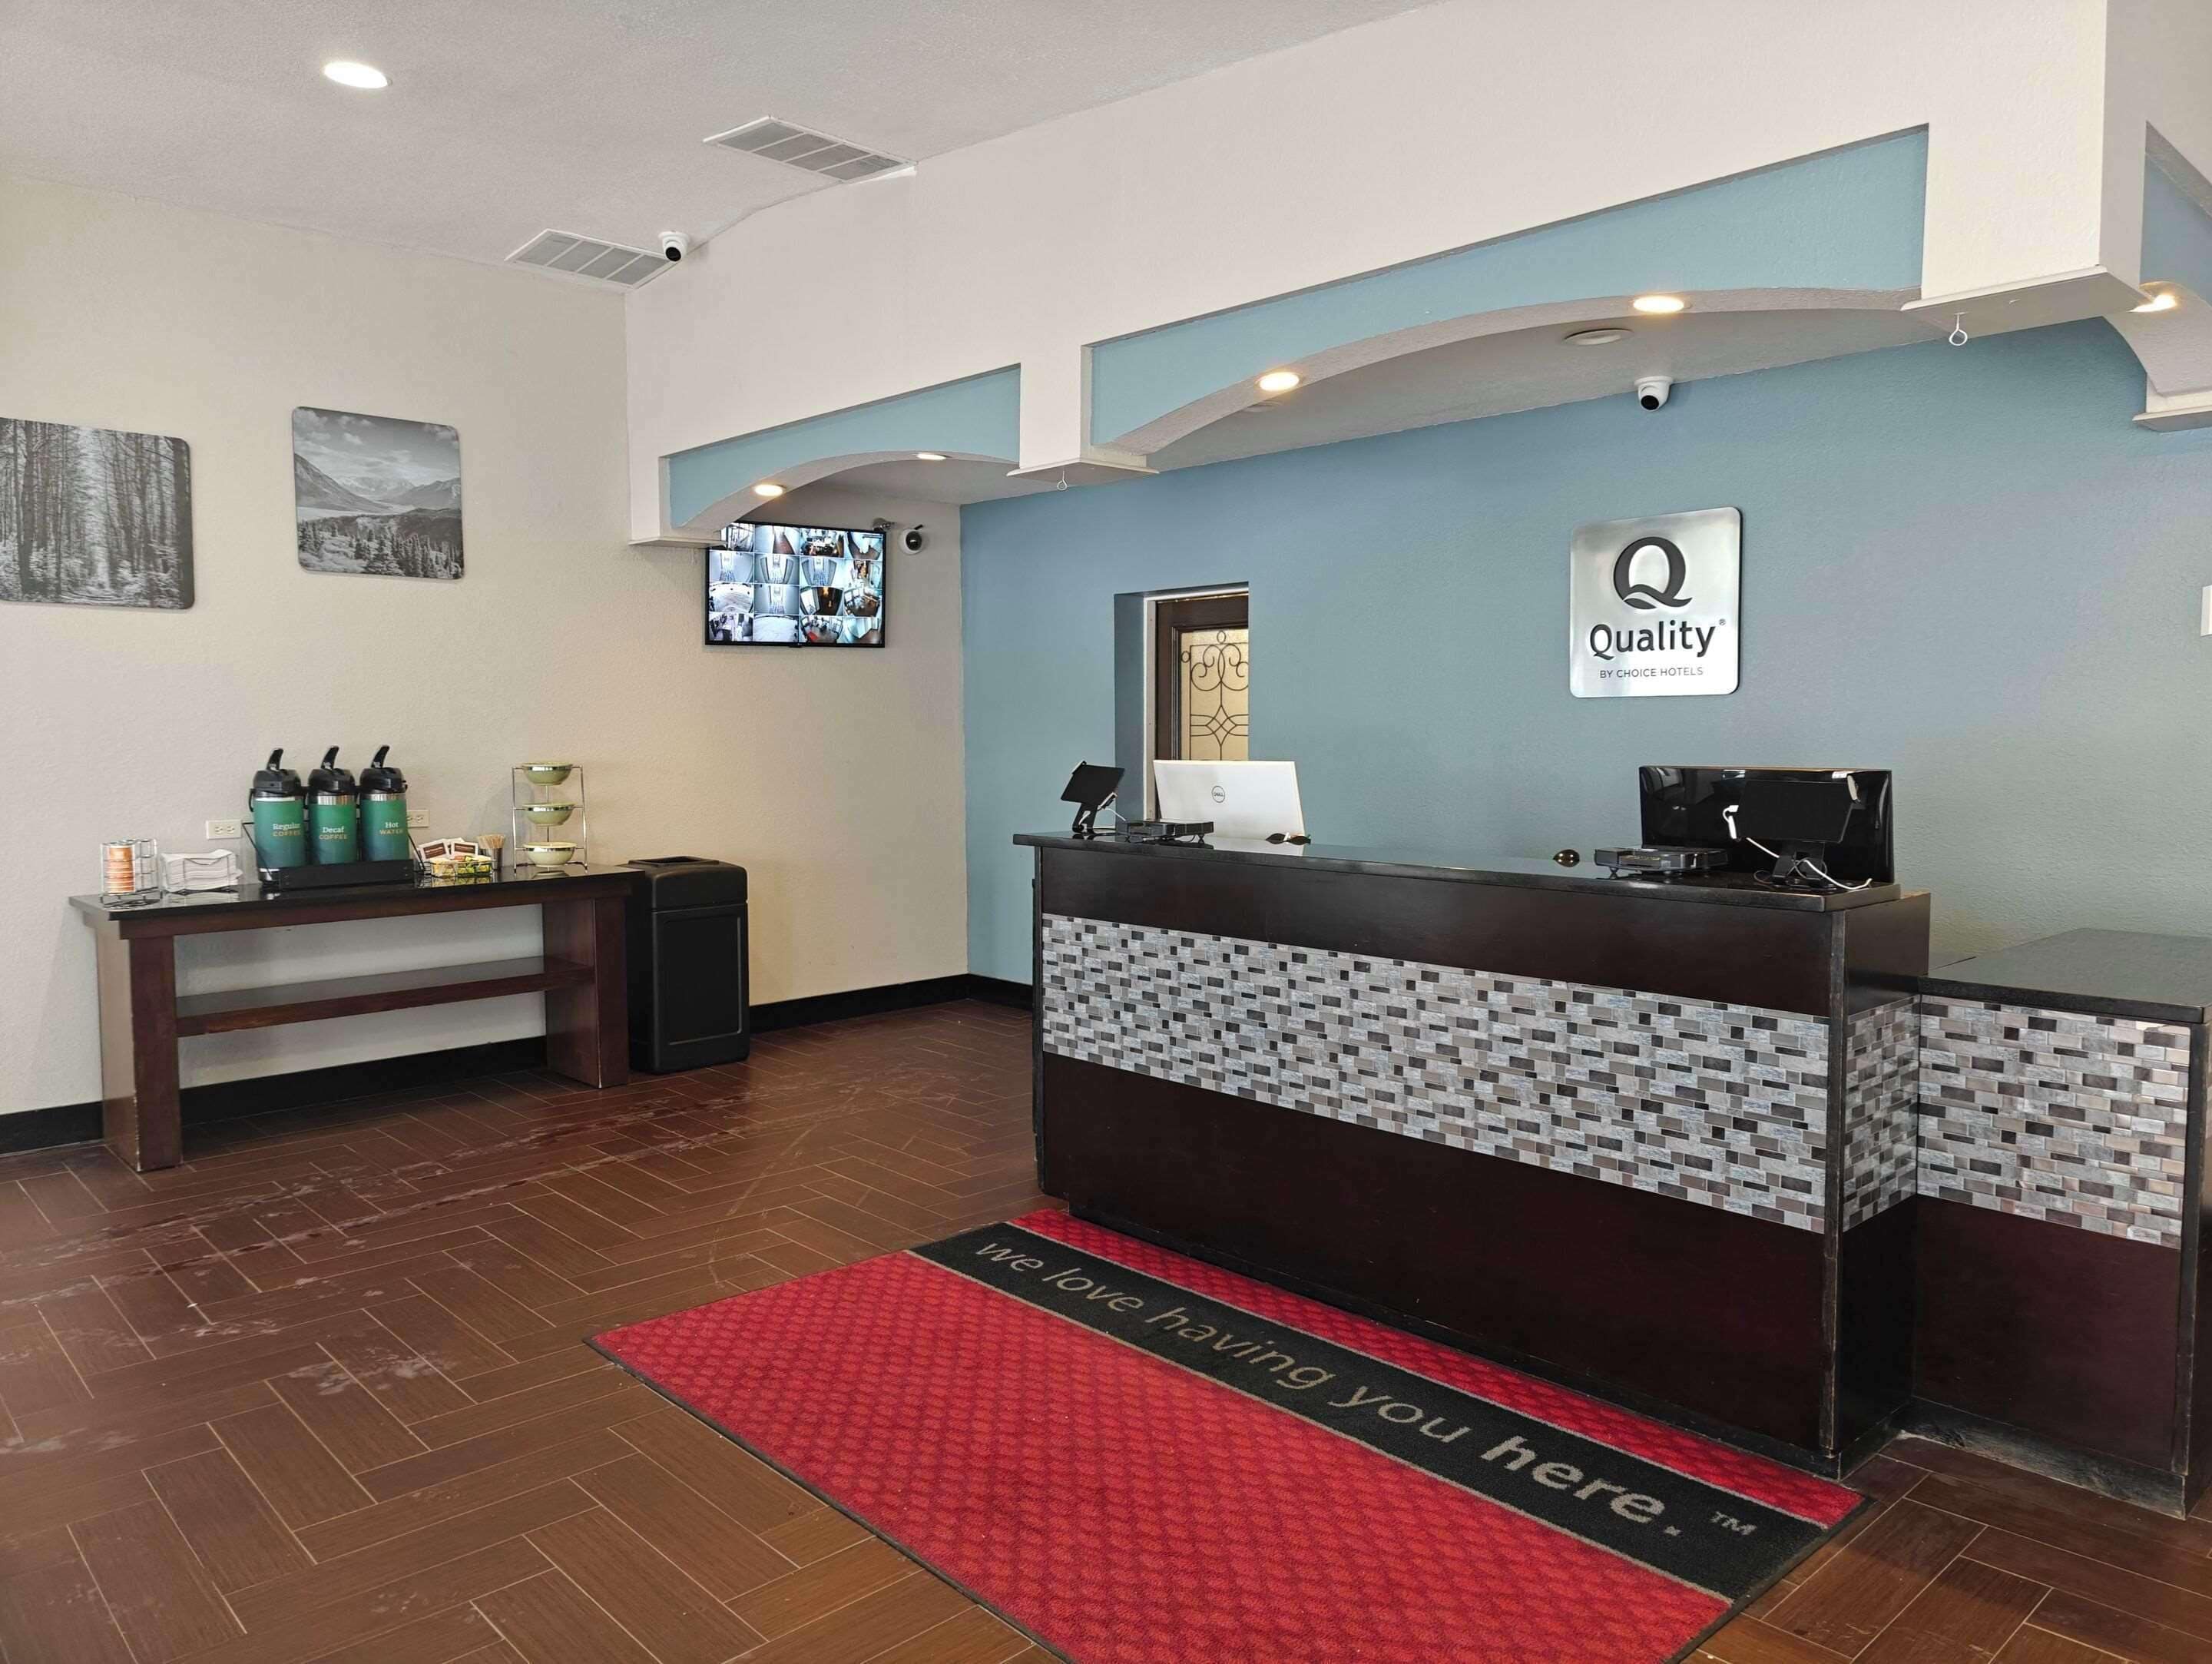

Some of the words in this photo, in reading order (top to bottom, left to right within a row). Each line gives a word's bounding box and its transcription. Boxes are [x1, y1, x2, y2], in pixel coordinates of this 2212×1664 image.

[1614, 536, 1693, 609] Q
[1616, 668, 1657, 678] CHOICE
[1660, 667, 1704, 676] HOTELS
[273, 823, 301, 831] Regular
[975, 1243, 1044, 1271] we
[1041, 1268, 1144, 1312] love
[1145, 1307, 1336, 1391] having
[1328, 1386, 1471, 1444] you
[1480, 1435, 1682, 1536] here.
